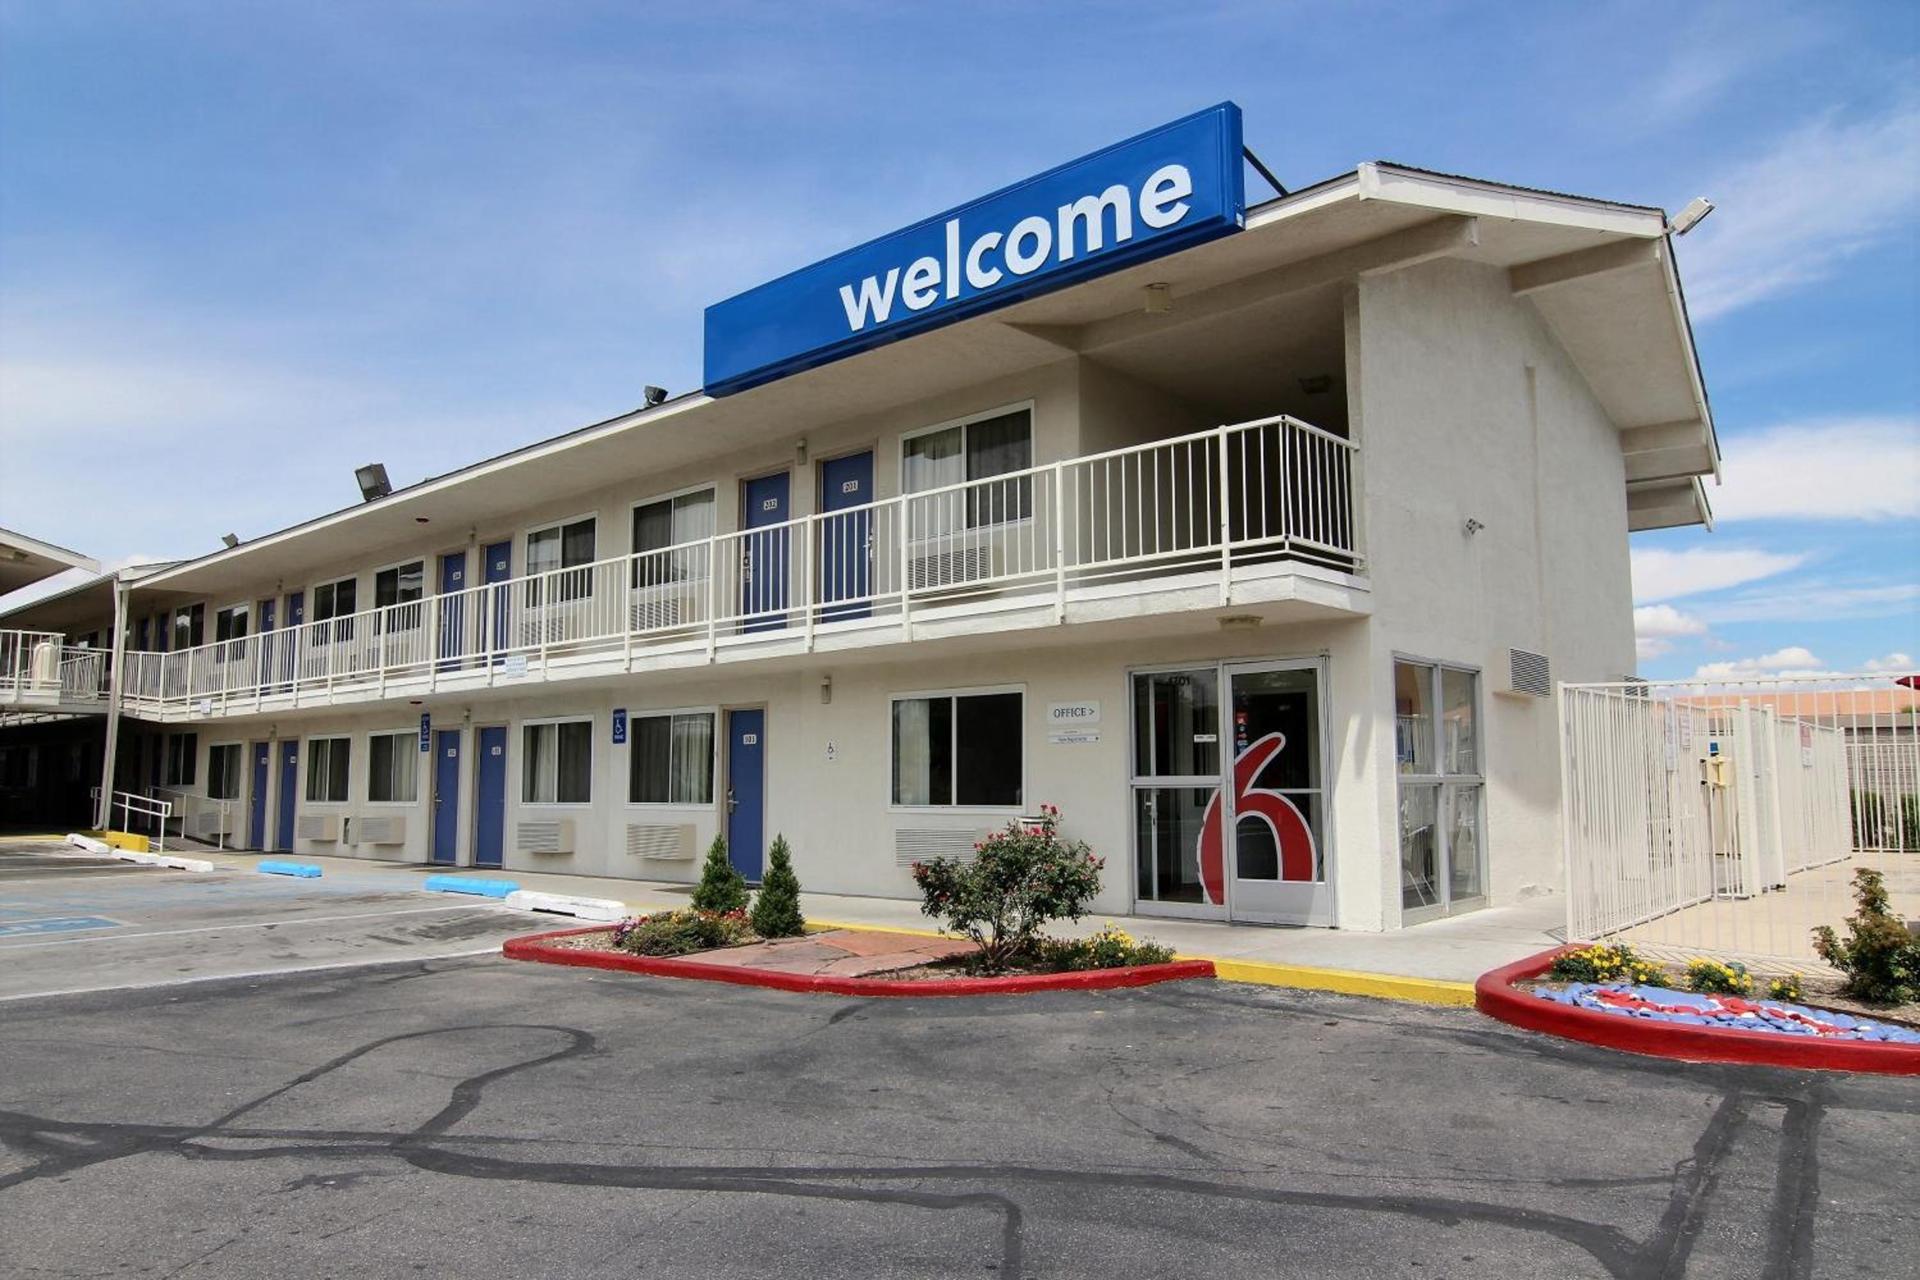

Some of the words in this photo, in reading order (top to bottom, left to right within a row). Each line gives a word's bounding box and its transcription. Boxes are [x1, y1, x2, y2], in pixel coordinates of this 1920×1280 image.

[838, 163, 1193, 332] welcome
[1054, 707, 1086, 718] OFFICE
[1196, 731, 1317, 907] 6
